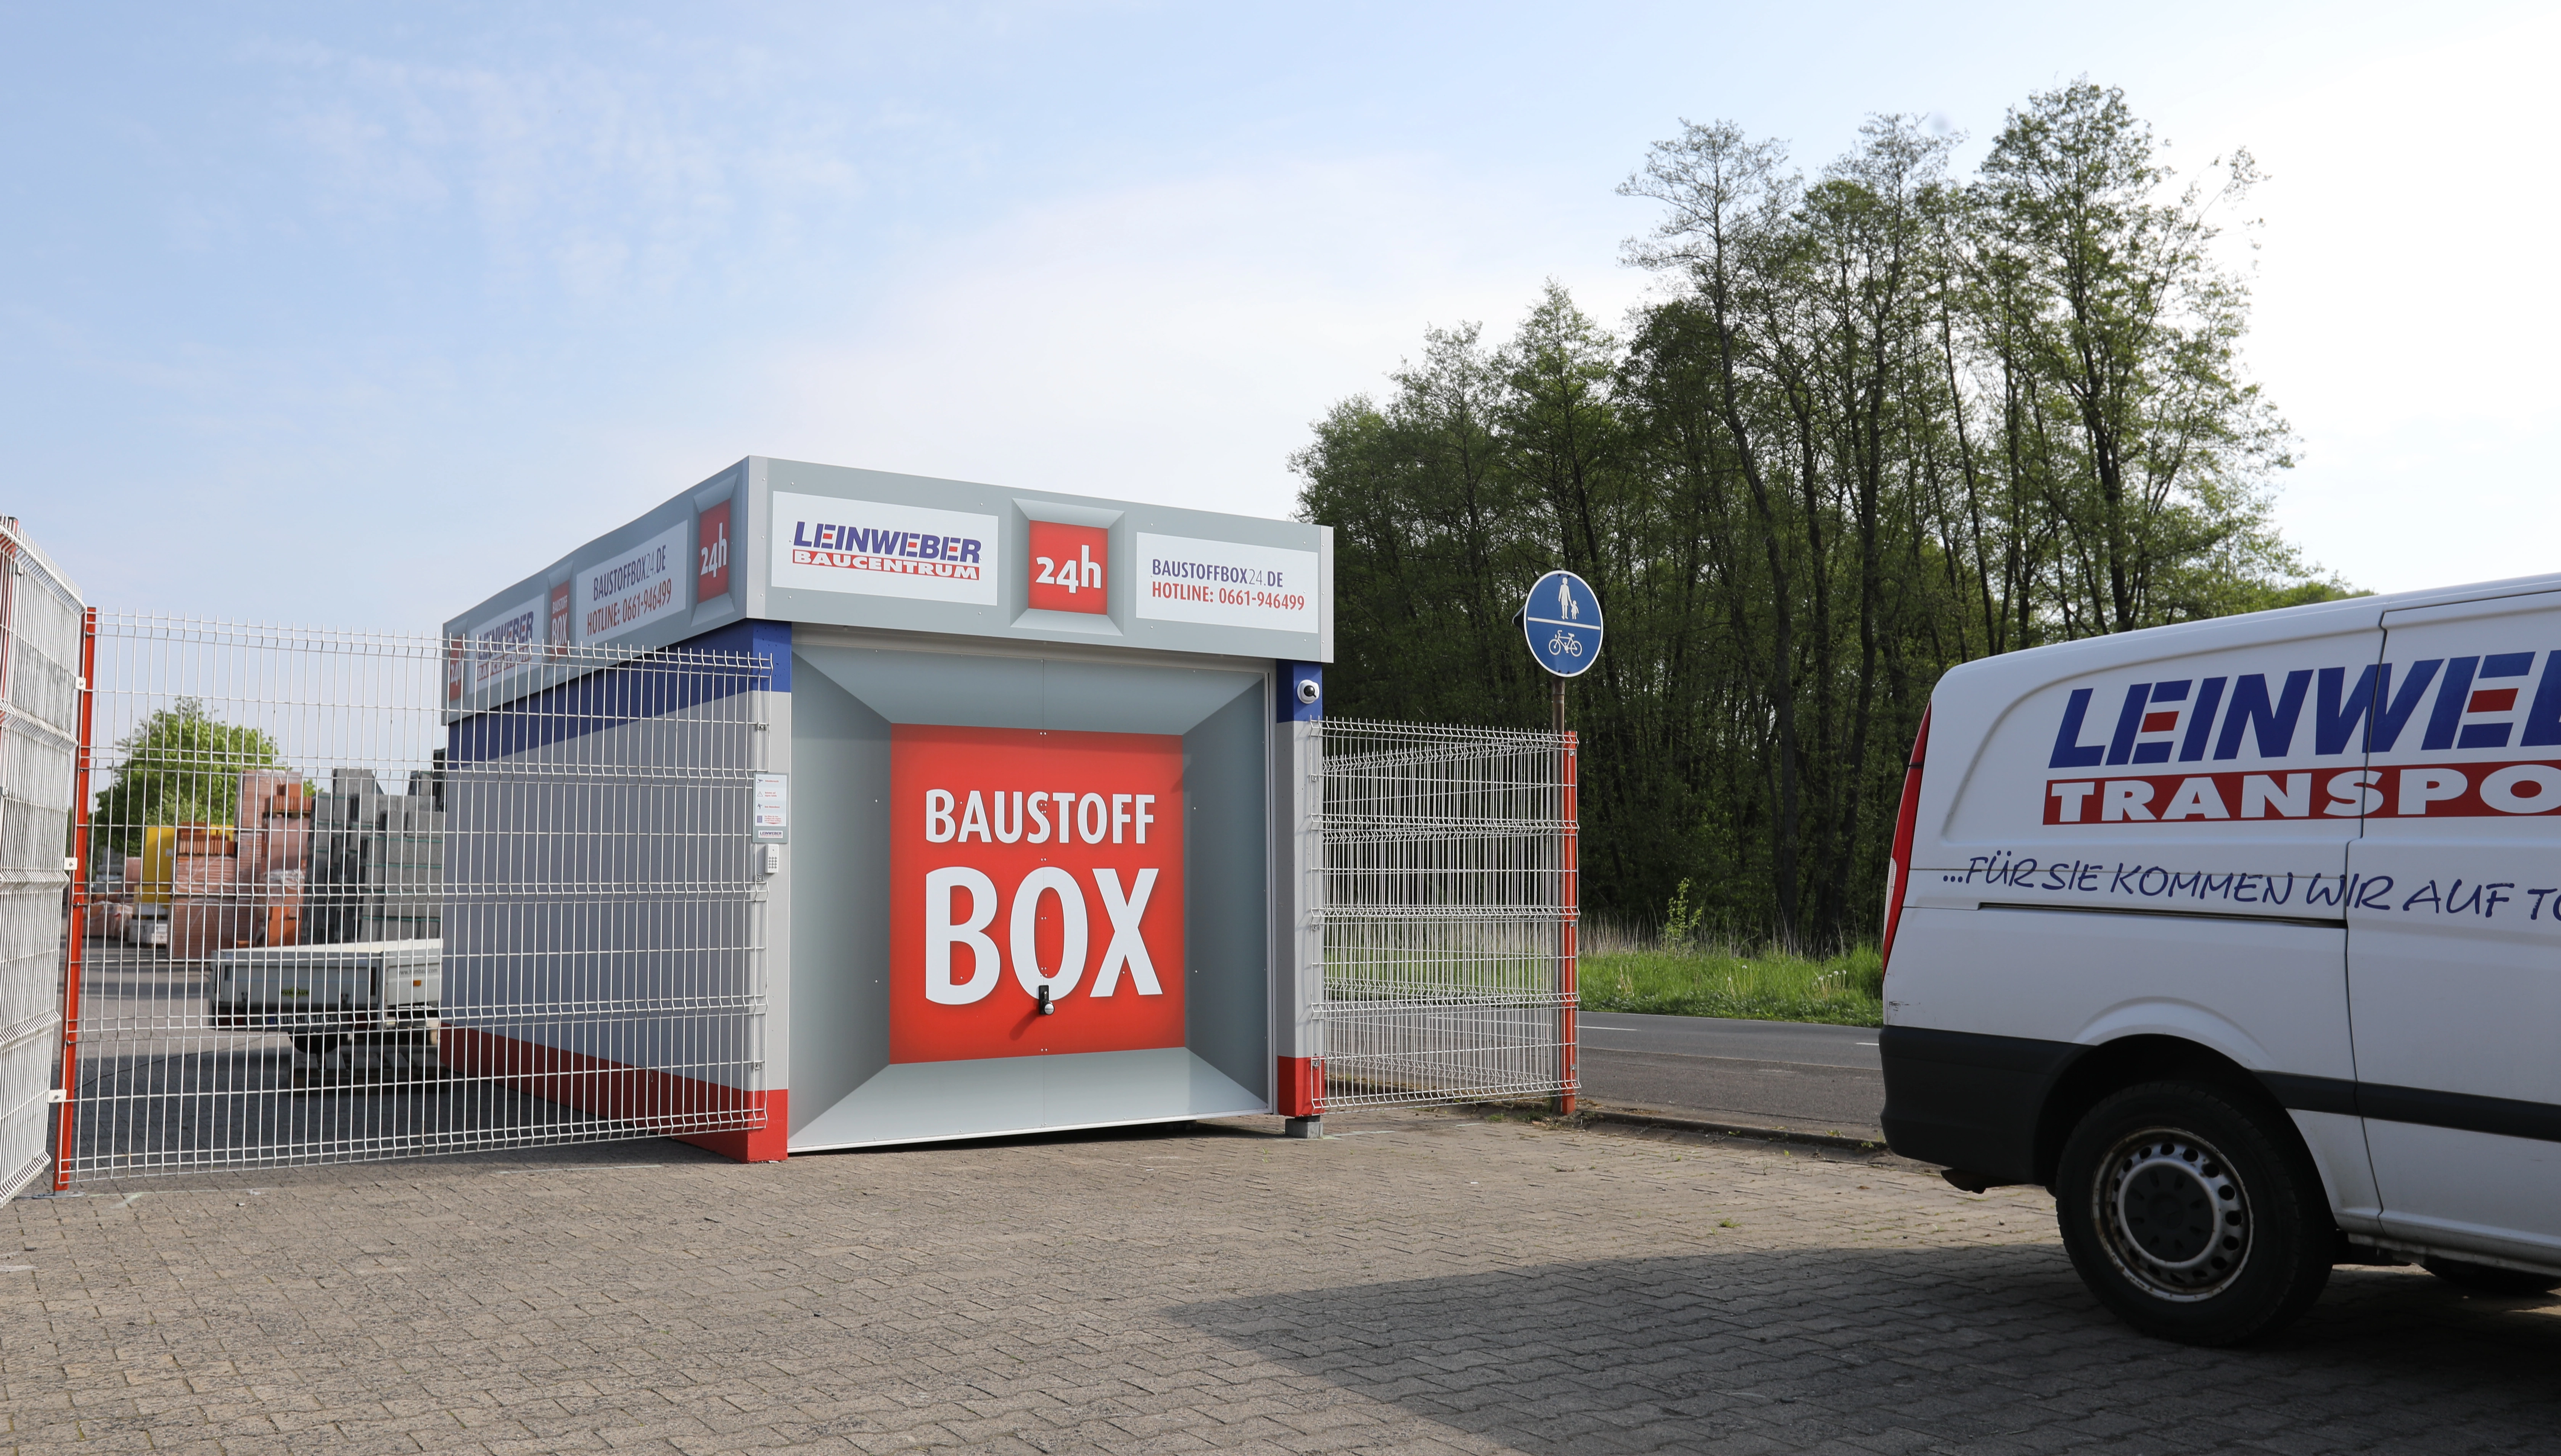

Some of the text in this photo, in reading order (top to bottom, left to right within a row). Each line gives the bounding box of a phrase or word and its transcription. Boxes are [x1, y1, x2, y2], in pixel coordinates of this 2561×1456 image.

[700, 522, 727, 578] 24h
[793, 521, 982, 564] LEINWEBER
[794, 550, 978, 580] BAUCENTRUM
[1035, 544, 1102, 594] 24h
[594, 544, 666, 601] BAUSTOFFBOX24.DE
[1152, 558, 1284, 588] BAUSTOFFBOX24.DE
[1152, 581, 1305, 611] HOTLINE: 0661-946499
[552, 595, 568, 614] BAUSTOFF
[552, 612, 568, 649] BOX
[587, 578, 672, 636] HOTLINE: 0661-946499
[925, 788, 1155, 845] BAUSTOFF
[2051, 764, 2561, 823] TRANSPO
[1943, 850, 2561, 922] ...FÜR SIE KOMMEN WIR AUF T
[925, 866, 1163, 1006] BOX
